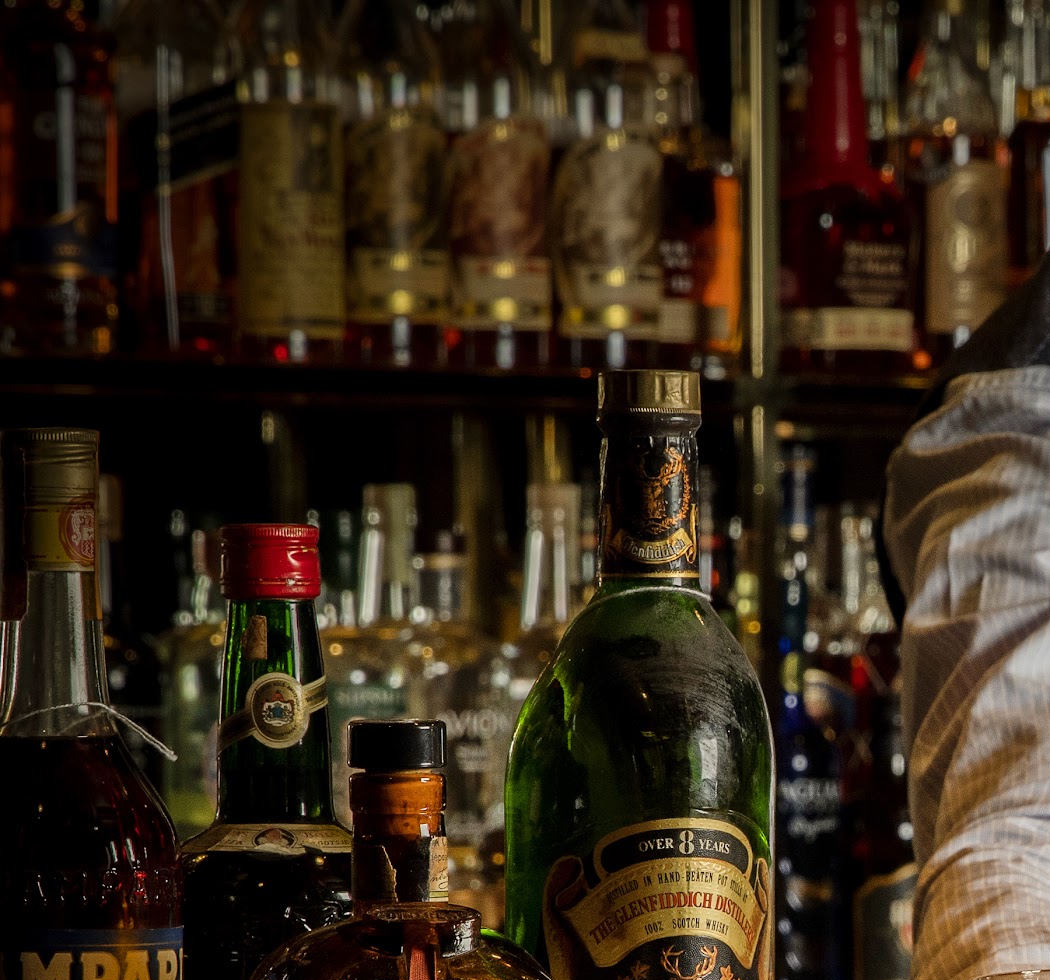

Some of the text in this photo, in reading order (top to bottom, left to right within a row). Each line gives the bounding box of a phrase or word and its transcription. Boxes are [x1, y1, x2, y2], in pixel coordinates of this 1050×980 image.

[639, 830, 730, 855] OVER 8 YEARS
[643, 876, 652, 887] IN
[717, 874, 728, 886] POT
[590, 917, 617, 945] THE
[614, 891, 714, 925] GLENFIDDICH
[672, 917, 700, 929] SCOTCH
[705, 918, 729, 936] WHISKY
